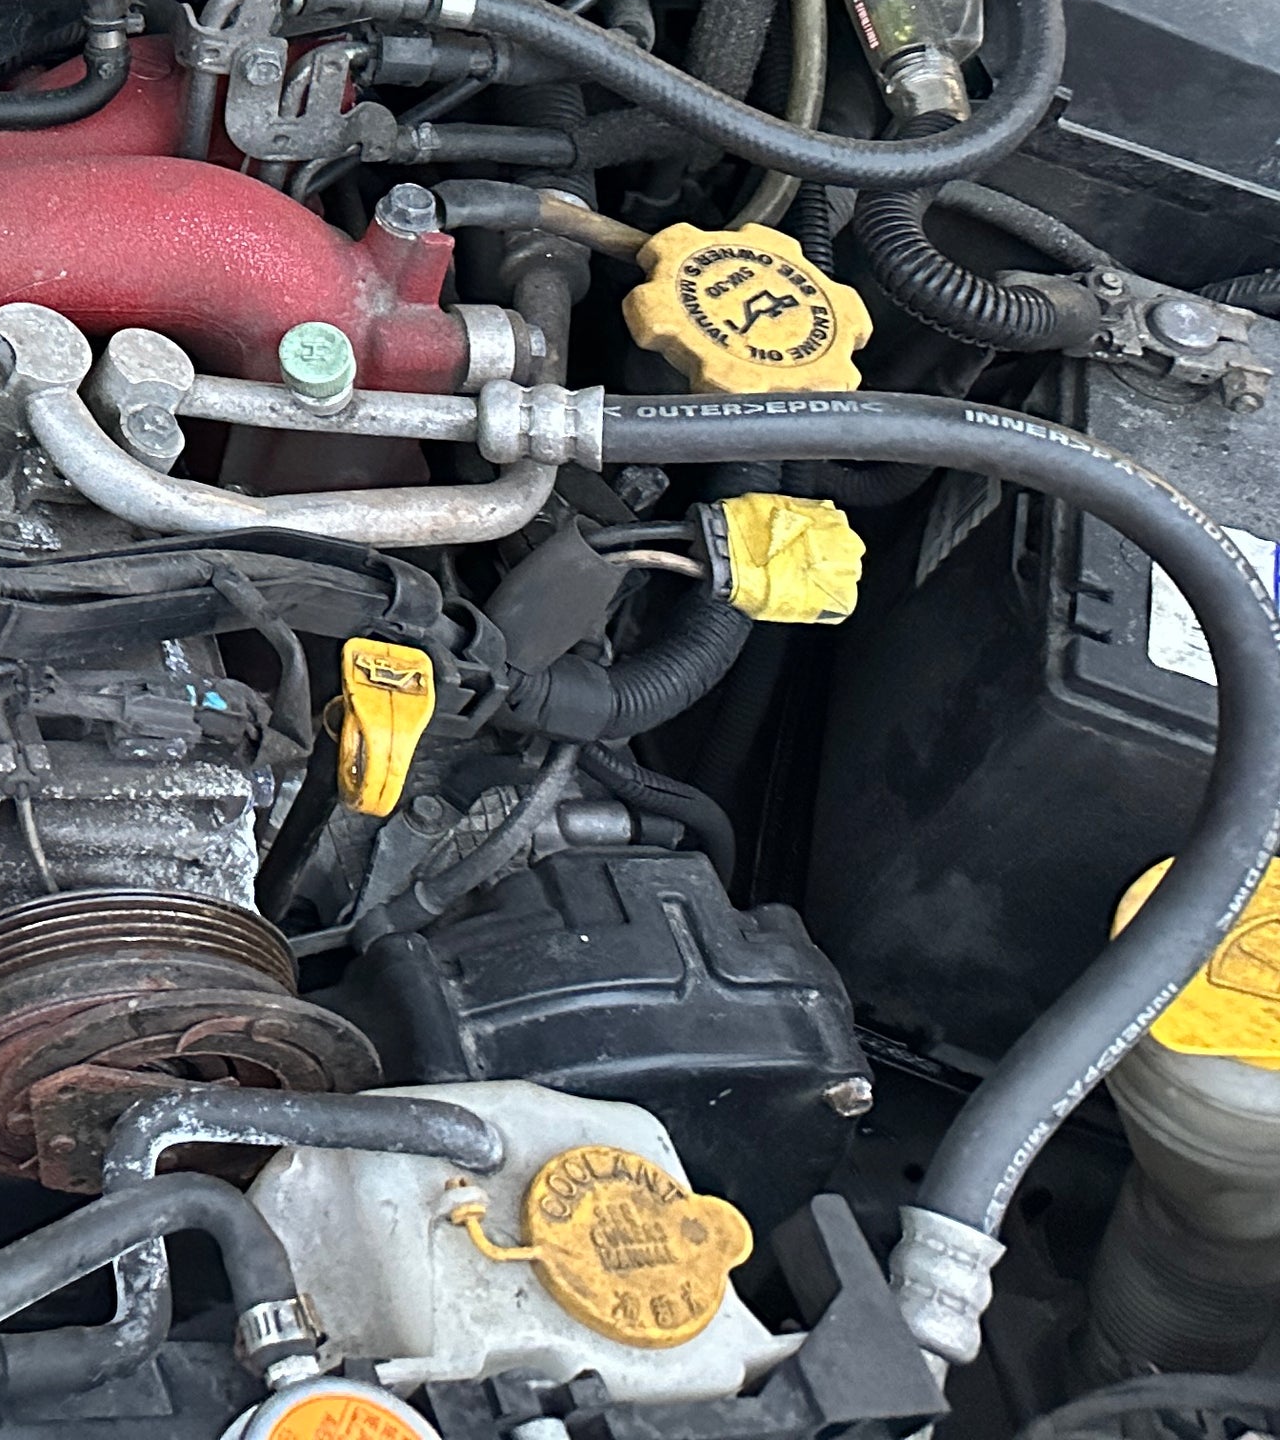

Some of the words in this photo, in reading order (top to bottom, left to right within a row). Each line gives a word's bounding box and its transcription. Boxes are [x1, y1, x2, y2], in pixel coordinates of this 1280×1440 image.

[704, 265, 756, 299] 5W-30
[777, 263, 818, 298] SEE
[680, 277, 730, 348] MANUAL
[786, 304, 829, 362] ENGINE
[748, 344, 784, 362] OIL
[538, 1153, 686, 1220] COOLANT
